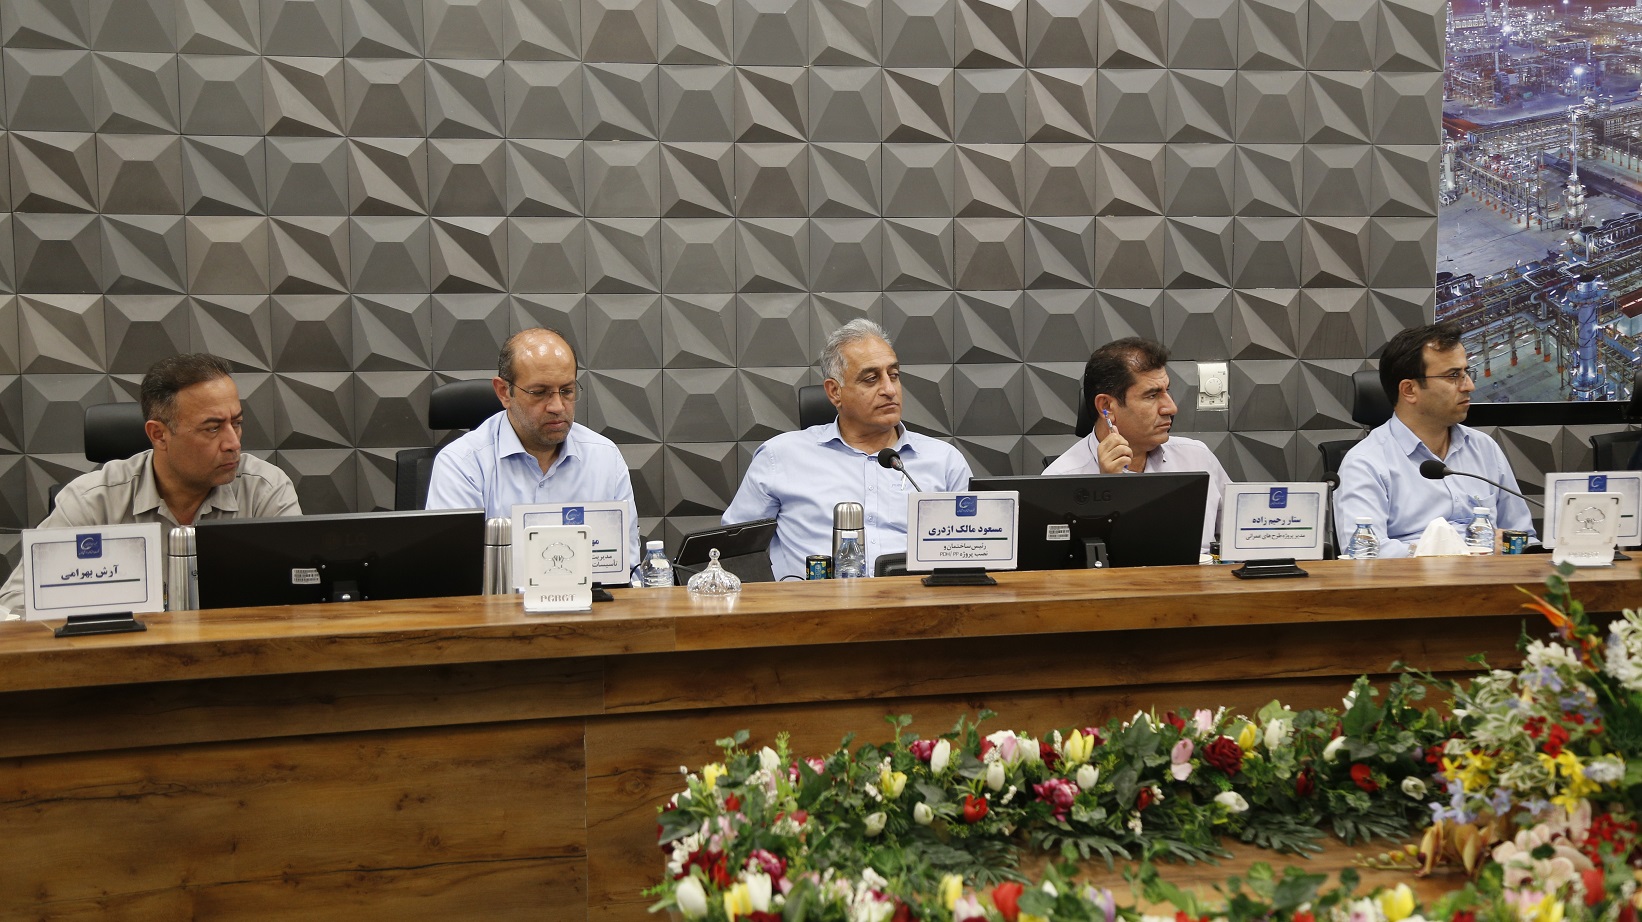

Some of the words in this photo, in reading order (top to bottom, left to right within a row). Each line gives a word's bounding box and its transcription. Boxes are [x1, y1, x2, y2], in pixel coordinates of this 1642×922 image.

[1093, 490, 1112, 502] LG
[1252, 516, 1267, 526] زاده
[1269, 517, 1285, 525] رحیم
[1287, 516, 1301, 525] ستار
[955, 524, 976, 533] مالک
[977, 525, 1003, 535] مسعود
[61, 568, 93, 580] بهرامی
[95, 564, 119, 578] آرش
